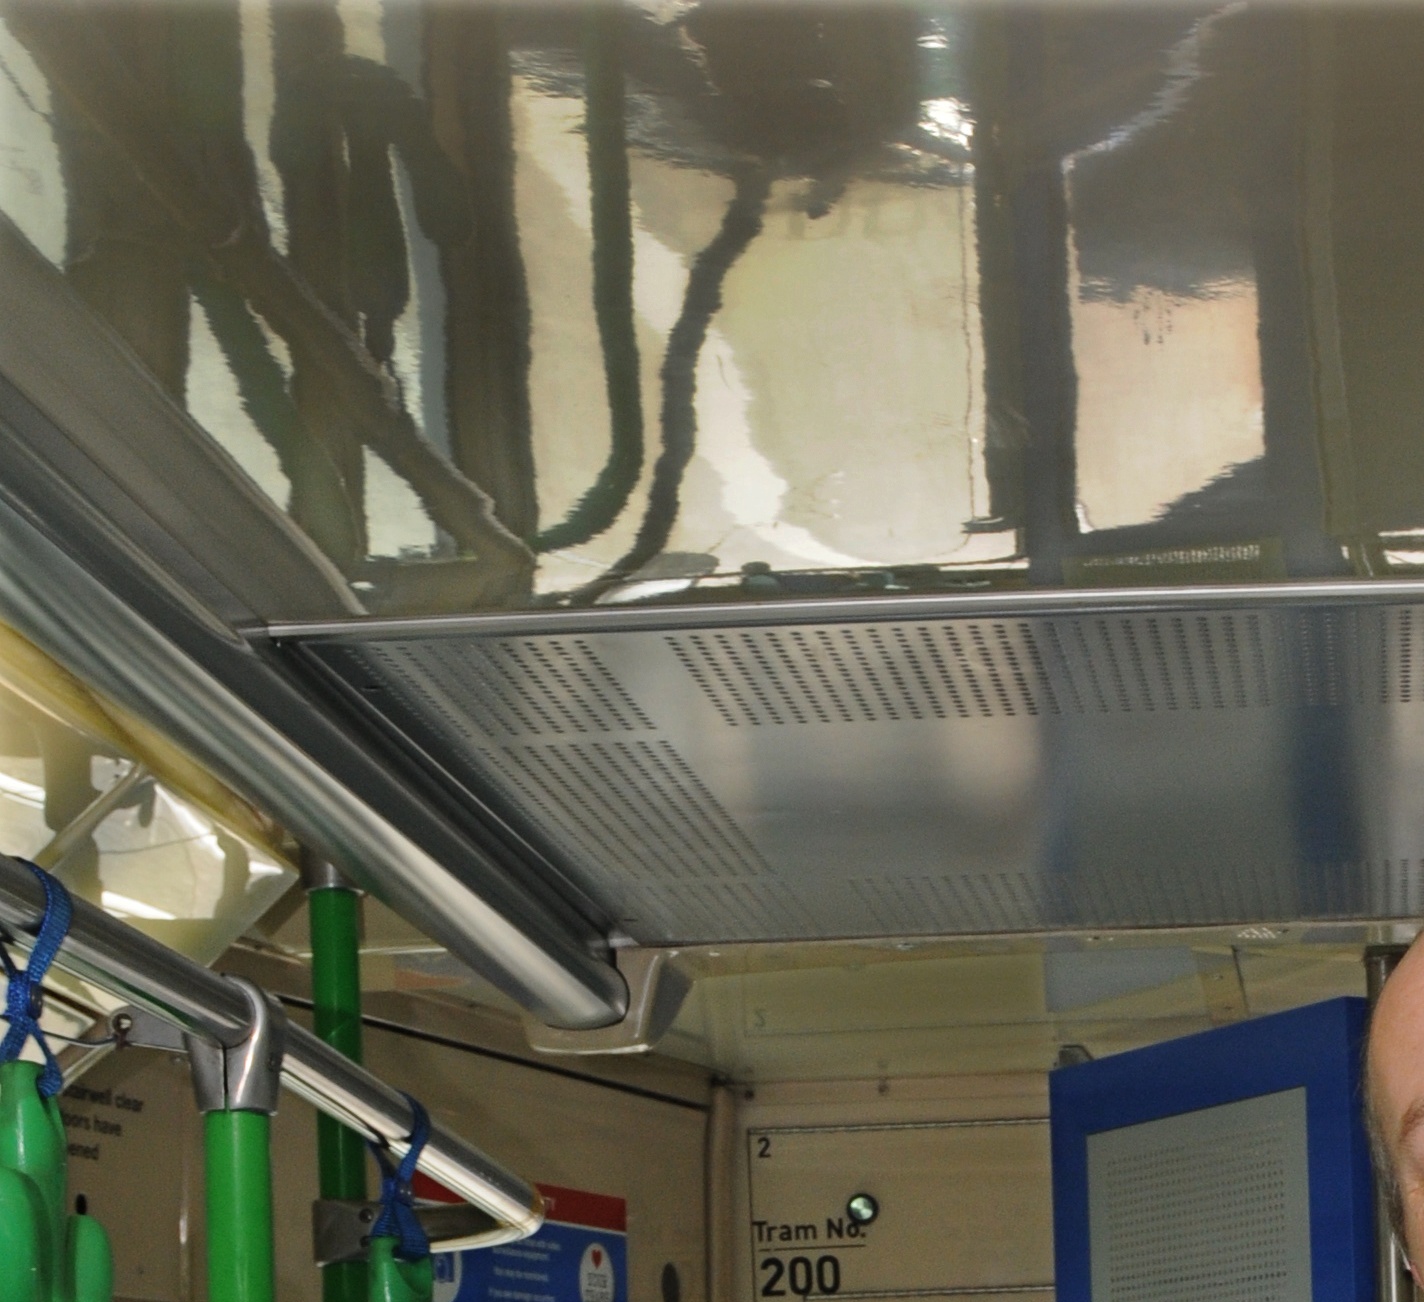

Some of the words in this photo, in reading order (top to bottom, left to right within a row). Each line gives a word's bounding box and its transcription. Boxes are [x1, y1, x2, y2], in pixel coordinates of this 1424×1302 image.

[757, 1137, 771, 1158] 2
[752, 1220, 817, 1242] Tram
[827, 1218, 866, 1239] No.
[760, 1255, 841, 1297] 200
